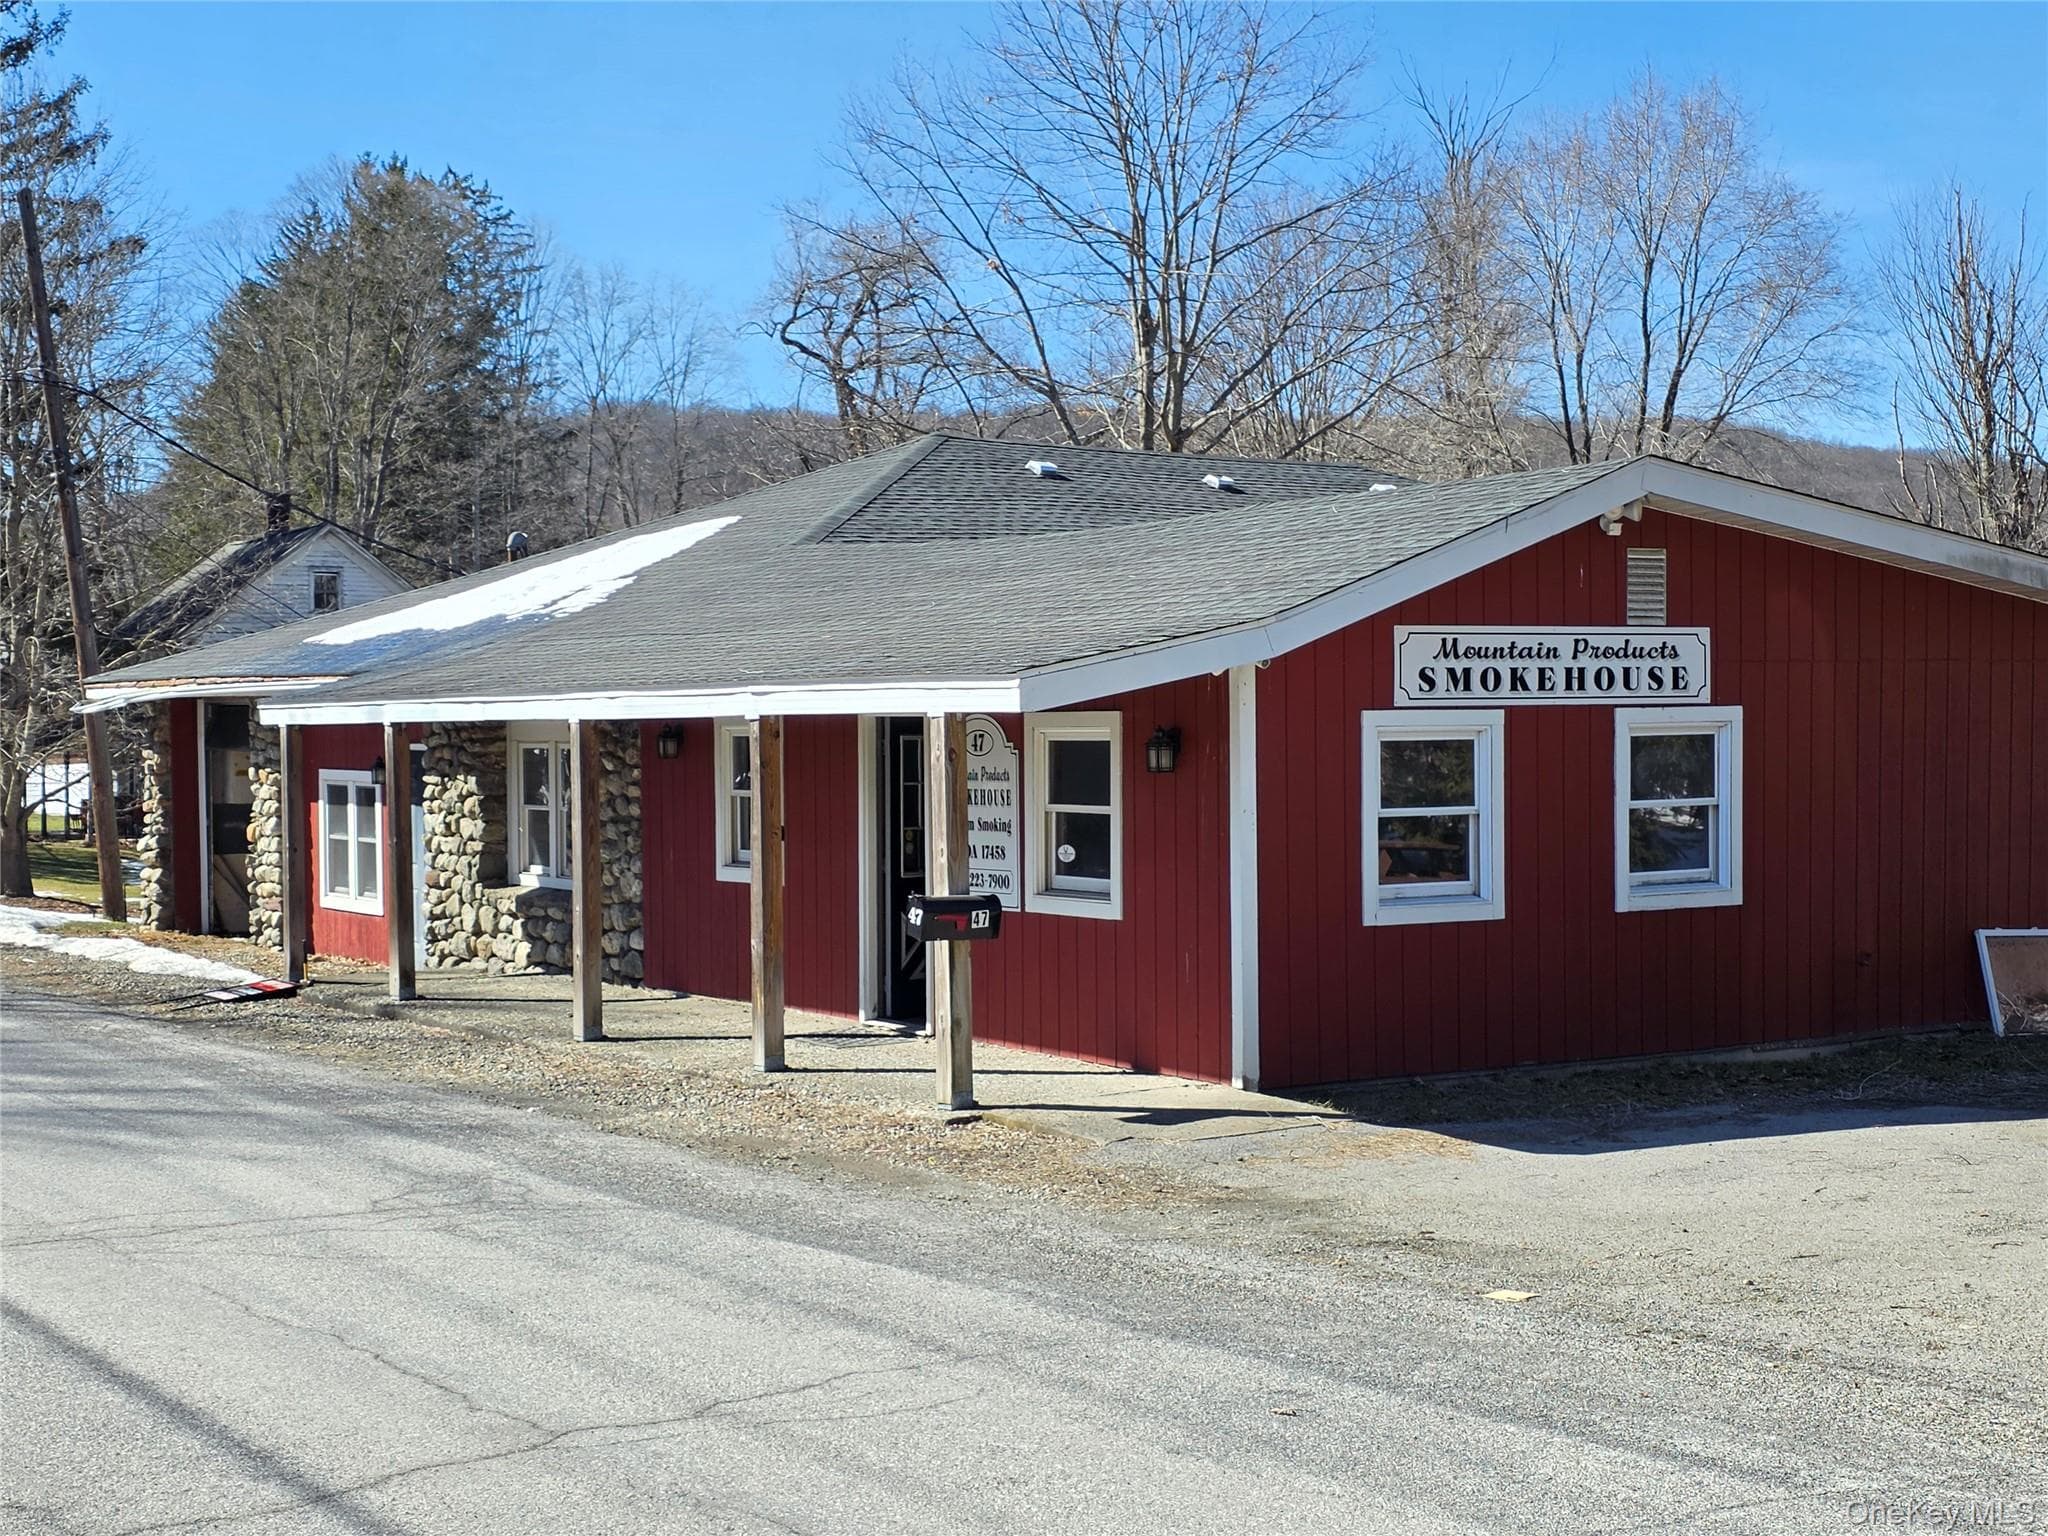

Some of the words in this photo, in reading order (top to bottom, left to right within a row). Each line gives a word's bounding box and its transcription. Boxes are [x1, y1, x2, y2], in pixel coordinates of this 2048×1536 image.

[1433, 637, 1561, 660] Mountain
[1571, 638, 1680, 660] Products
[1418, 666, 1690, 693] SMOKEHOUSE
[971, 733, 985, 752] 47
[981, 766, 1010, 782] Products
[967, 788, 1012, 807] KEHOUSE
[977, 816, 1012, 837] Smoking
[908, 906, 924, 926] 47
[973, 911, 988, 927] 47
